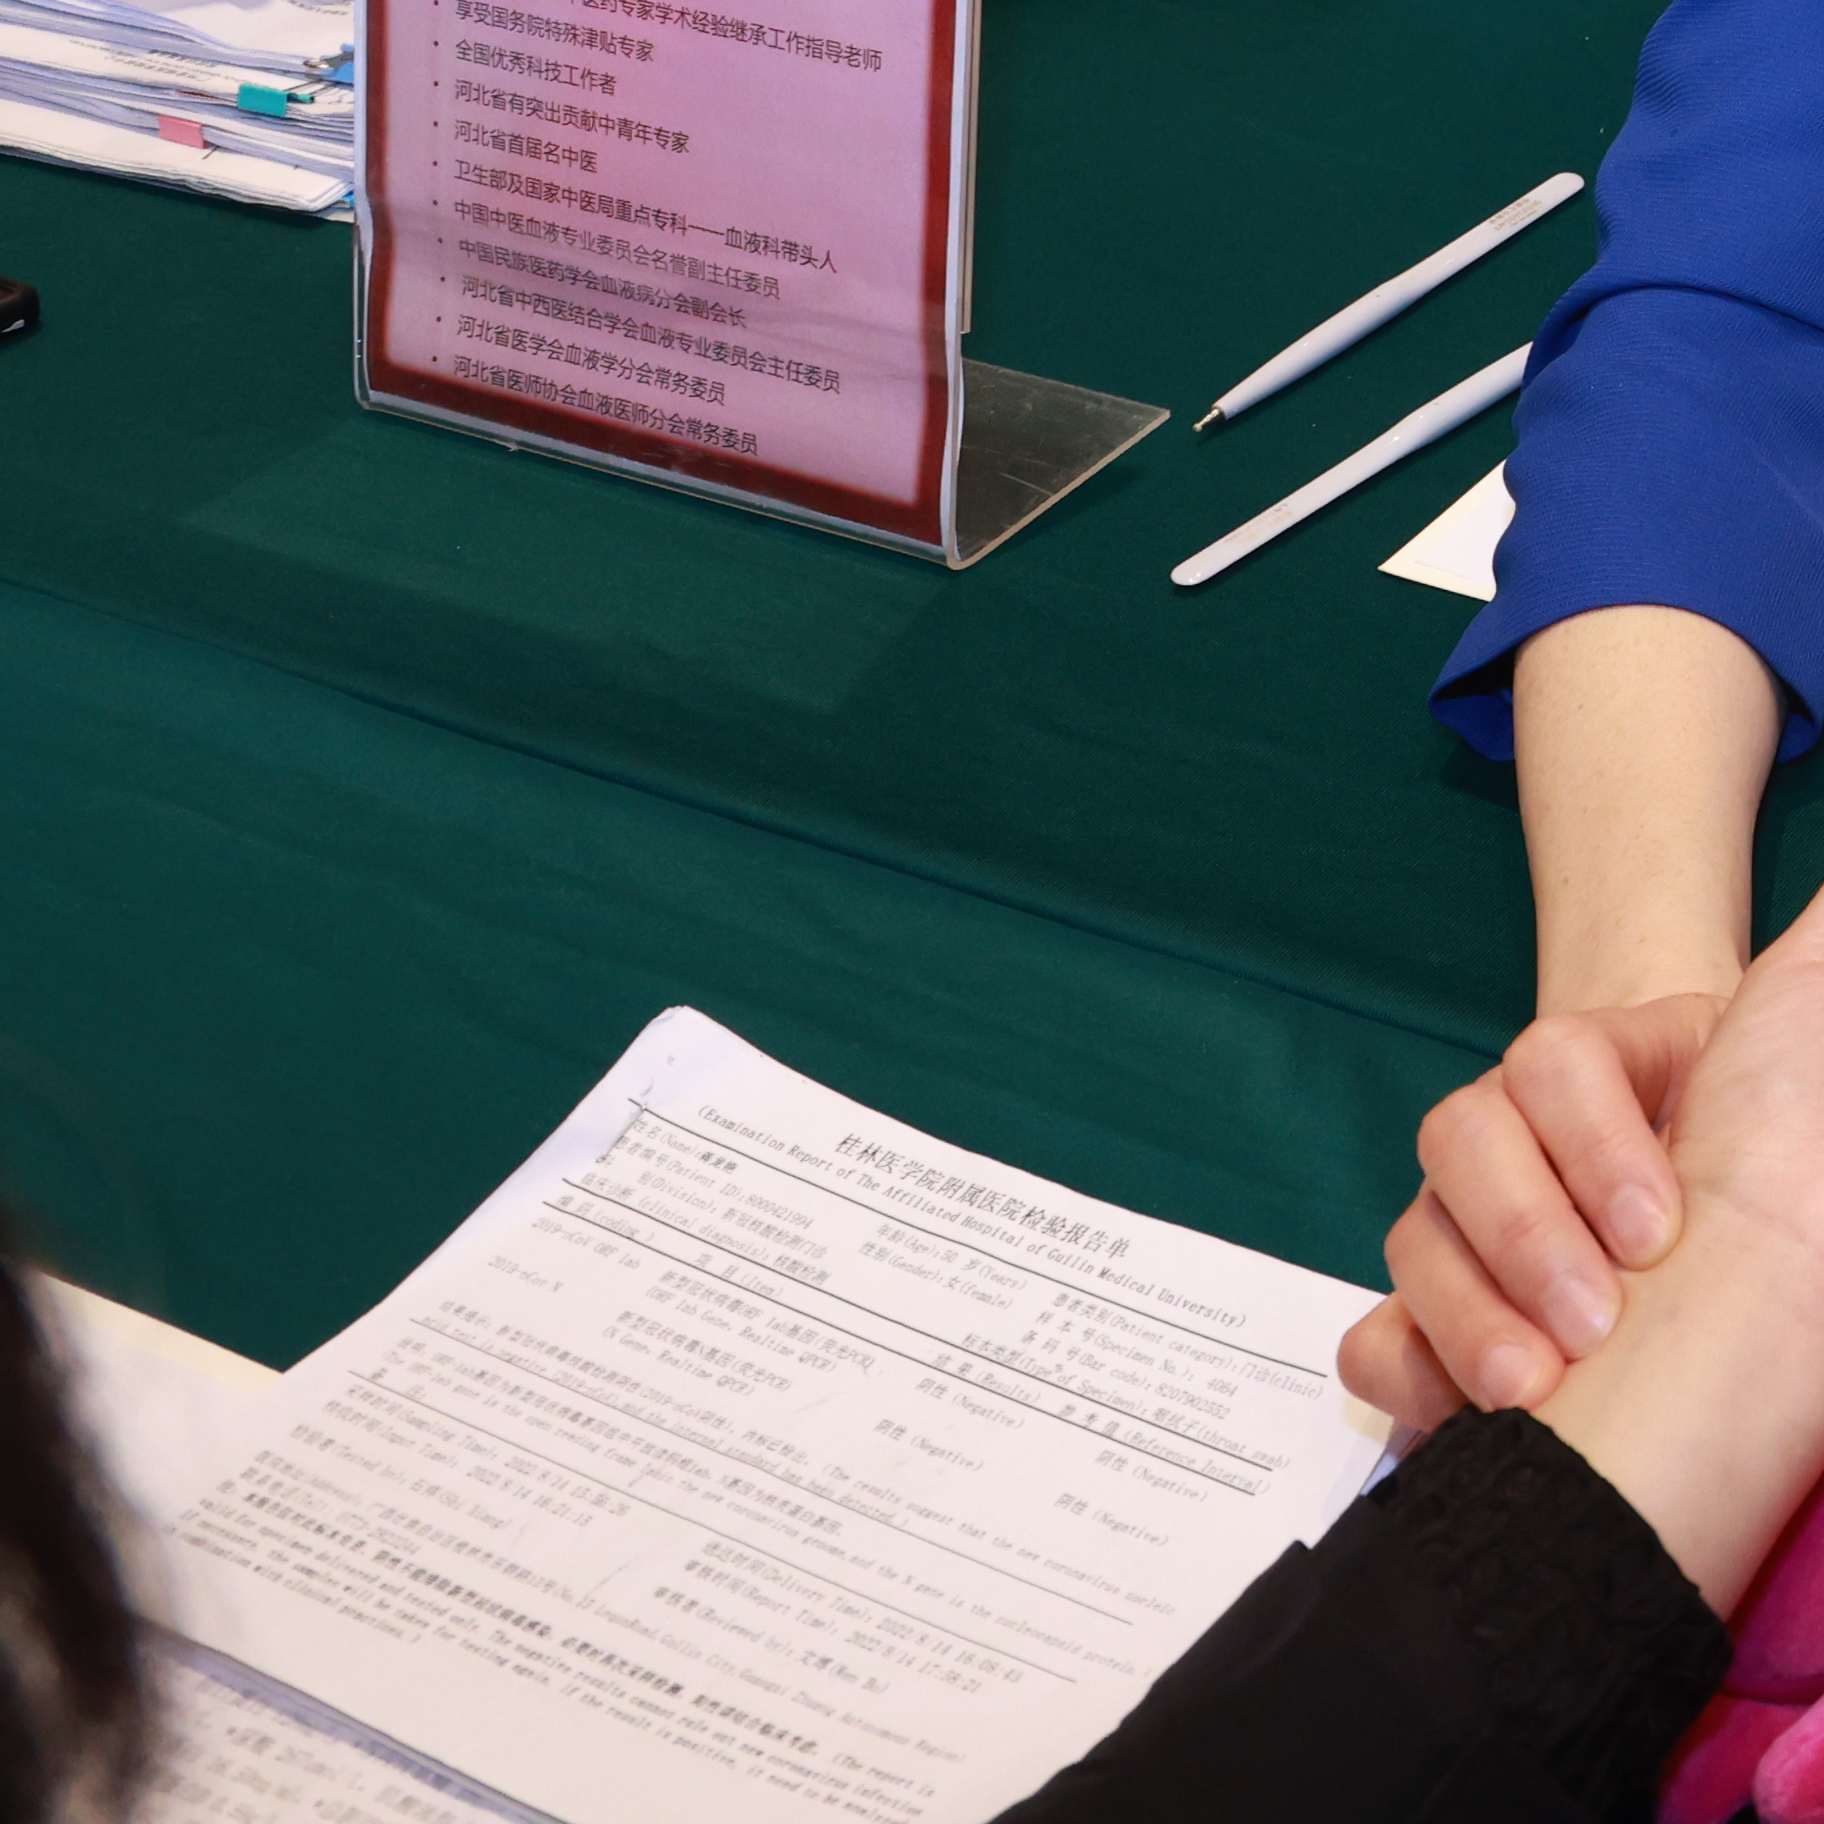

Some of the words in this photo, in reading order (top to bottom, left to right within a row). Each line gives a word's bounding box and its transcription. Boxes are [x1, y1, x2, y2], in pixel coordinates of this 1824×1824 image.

[455, 39, 617, 97] 全国优秀科技工作者
[455, 79, 690, 155] 河北省有突出贡献中青年专家
[455, 119, 598, 174] 河北省首届名中医
[691, 1103, 792, 1152] (Examination
[782, 1145, 837, 1174] Report
[833, 1164, 857, 1180] of
[855, 1174, 884, 1191] The
[880, 1184, 963, 1223] Affiliated
[957, 1214, 1020, 1246] Hospital
[1025, 1240, 1049, 1256] of
[1044, 1246, 1098, 1275] Guilin
[1096, 1265, 1157, 1296] Medical
[1154, 1284, 1249, 1332] University)
[830, 1131, 1135, 1264] 桂林医学院附属医院检验报告单
